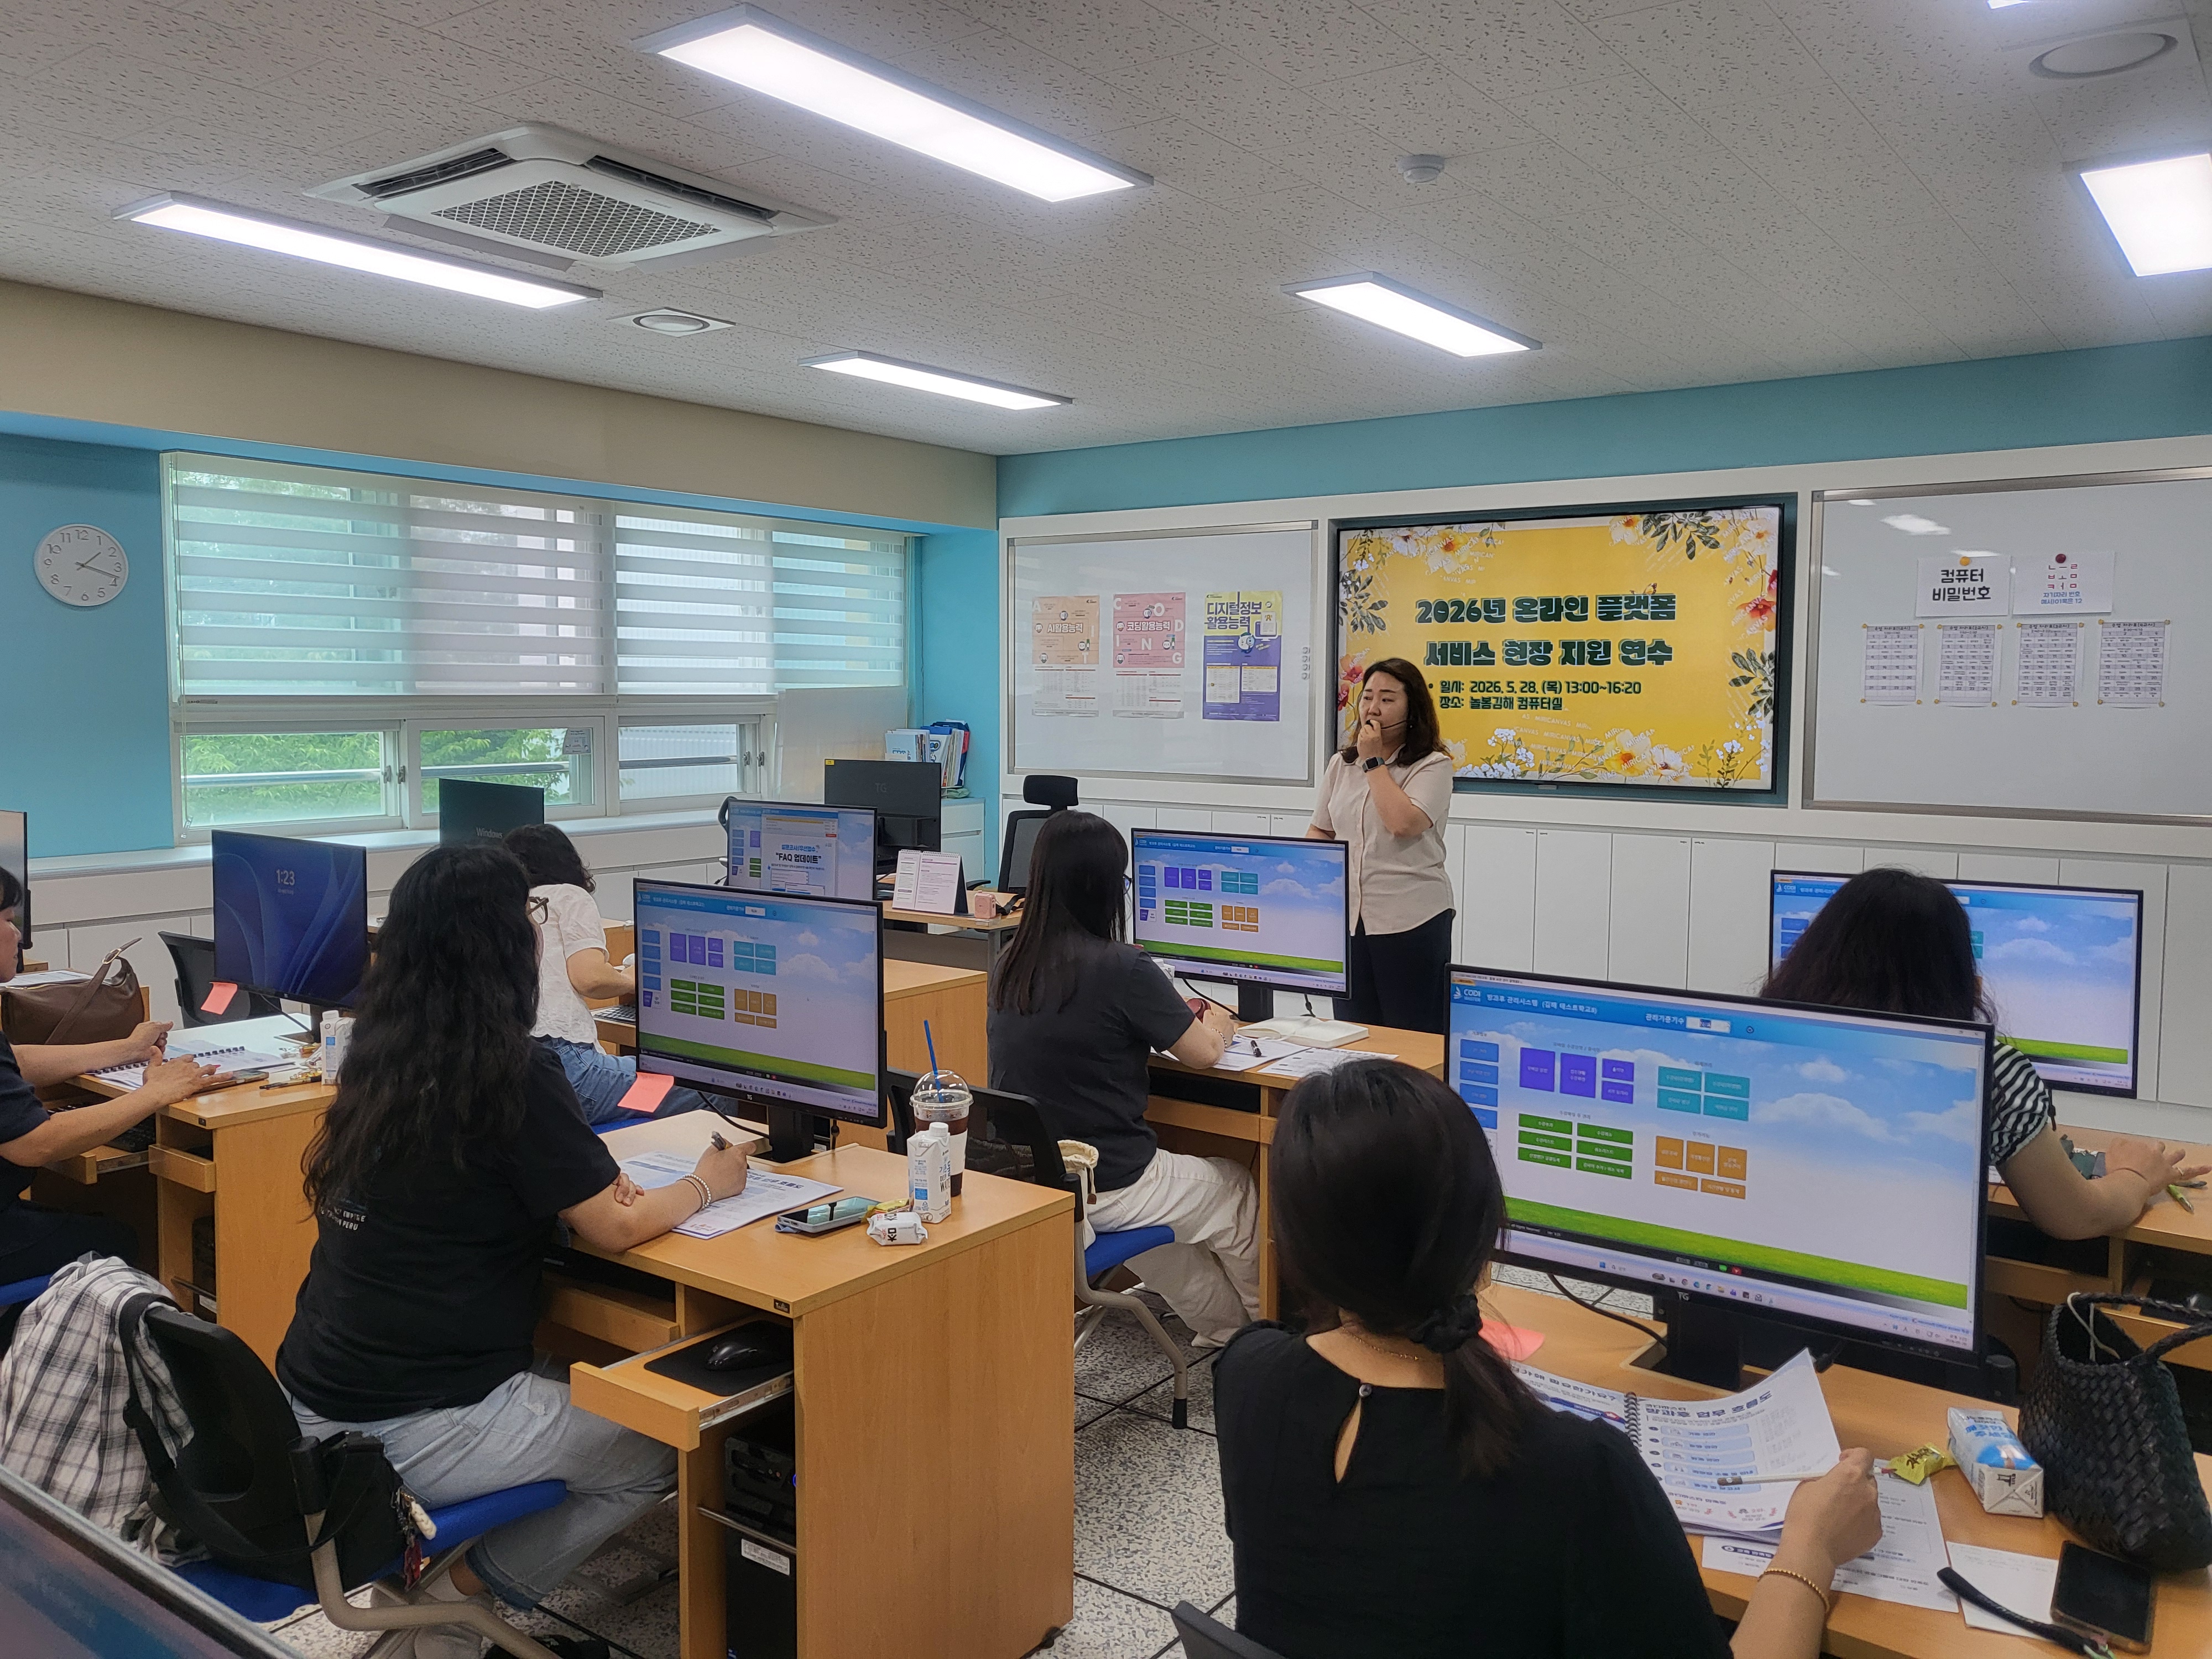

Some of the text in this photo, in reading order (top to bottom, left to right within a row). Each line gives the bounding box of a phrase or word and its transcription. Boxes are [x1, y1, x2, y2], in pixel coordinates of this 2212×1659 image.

[60, 533, 71, 542] 11
[75, 530, 89, 540] 12
[97, 536, 101, 545] 1
[47, 544, 61, 554] 10
[108, 547, 117, 557] 2
[113, 562, 122, 572] 3
[51, 574, 59, 585] 8
[1941, 568, 1984, 583] 컴퓨터
[64, 586, 72, 596] 7
[81, 591, 89, 601] 6
[97, 588, 105, 598] 5
[1932, 586, 1991, 602] 비밀번호
[1113, 598, 1121, 610] C
[1207, 599, 1262, 615] 디지털정보
[1416, 593, 1676, 623] 2026년 온라인 플랫폼
[1154, 603, 1165, 617] O
[1047, 623, 1083, 633] AI활용능력
[1127, 621, 1170, 632] 코딩활용능력
[1175, 619, 1183, 631] D
[1204, 616, 1250, 630] 활용능력
[1141, 638, 1151, 650] N
[1172, 652, 1182, 664] G
[1423, 639, 1673, 666] 서비스 현장 지원 연수
[1082, 653, 1089, 664] T
[1470, 681, 1504, 693] 2026.
[1505, 681, 1517, 693] 5.
[1520, 681, 1539, 693] 28.
[1542, 680, 1562, 694] (목)
[1566, 681, 1642, 694] 13:00~16:20
[1439, 697, 1464, 709] 장소:
[1517, 696, 1563, 711] 컴퓨터실
[276, 869, 295, 885] 1:23
[342, 1220, 358, 1230] PERU
[1677, 1291, 1689, 1301] TG
